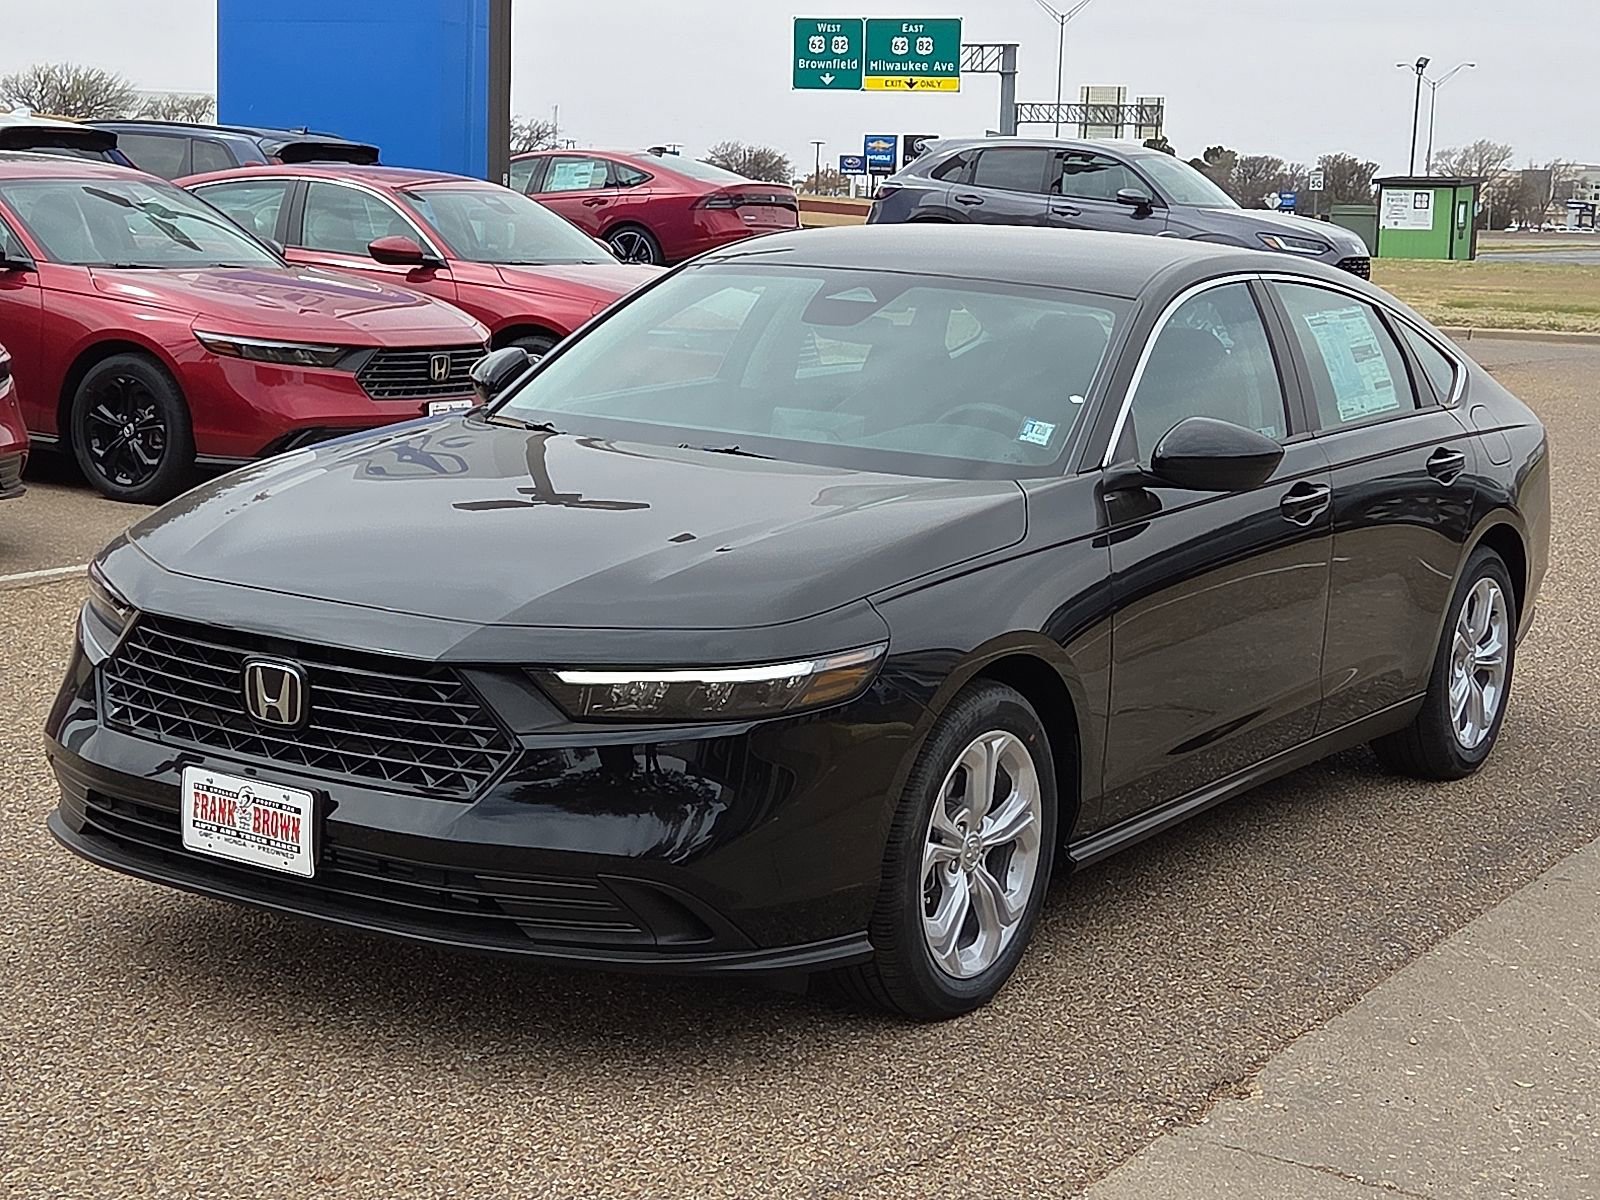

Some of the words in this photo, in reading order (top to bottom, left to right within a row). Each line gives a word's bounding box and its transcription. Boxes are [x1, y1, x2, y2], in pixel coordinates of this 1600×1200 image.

[816, 23, 841, 33] WEST
[902, 23, 924, 33] EAST
[810, 39, 824, 50] 62
[833, 39, 847, 50] 82
[893, 40, 907, 51] 62
[918, 40, 932, 51] 82
[798, 58, 858, 70] Brownfield
[869, 59, 929, 72] Milwaukee
[933, 61, 955, 72] Ave
[884, 79, 902, 88] EXIT
[920, 79, 943, 88] ONLY
[193, 791, 238, 828] FRANK
[252, 806, 301, 845] BROWN
[194, 821, 218, 833] AUTO
[219, 827, 237, 837] AND
[239, 832, 268, 845] TRUCK
